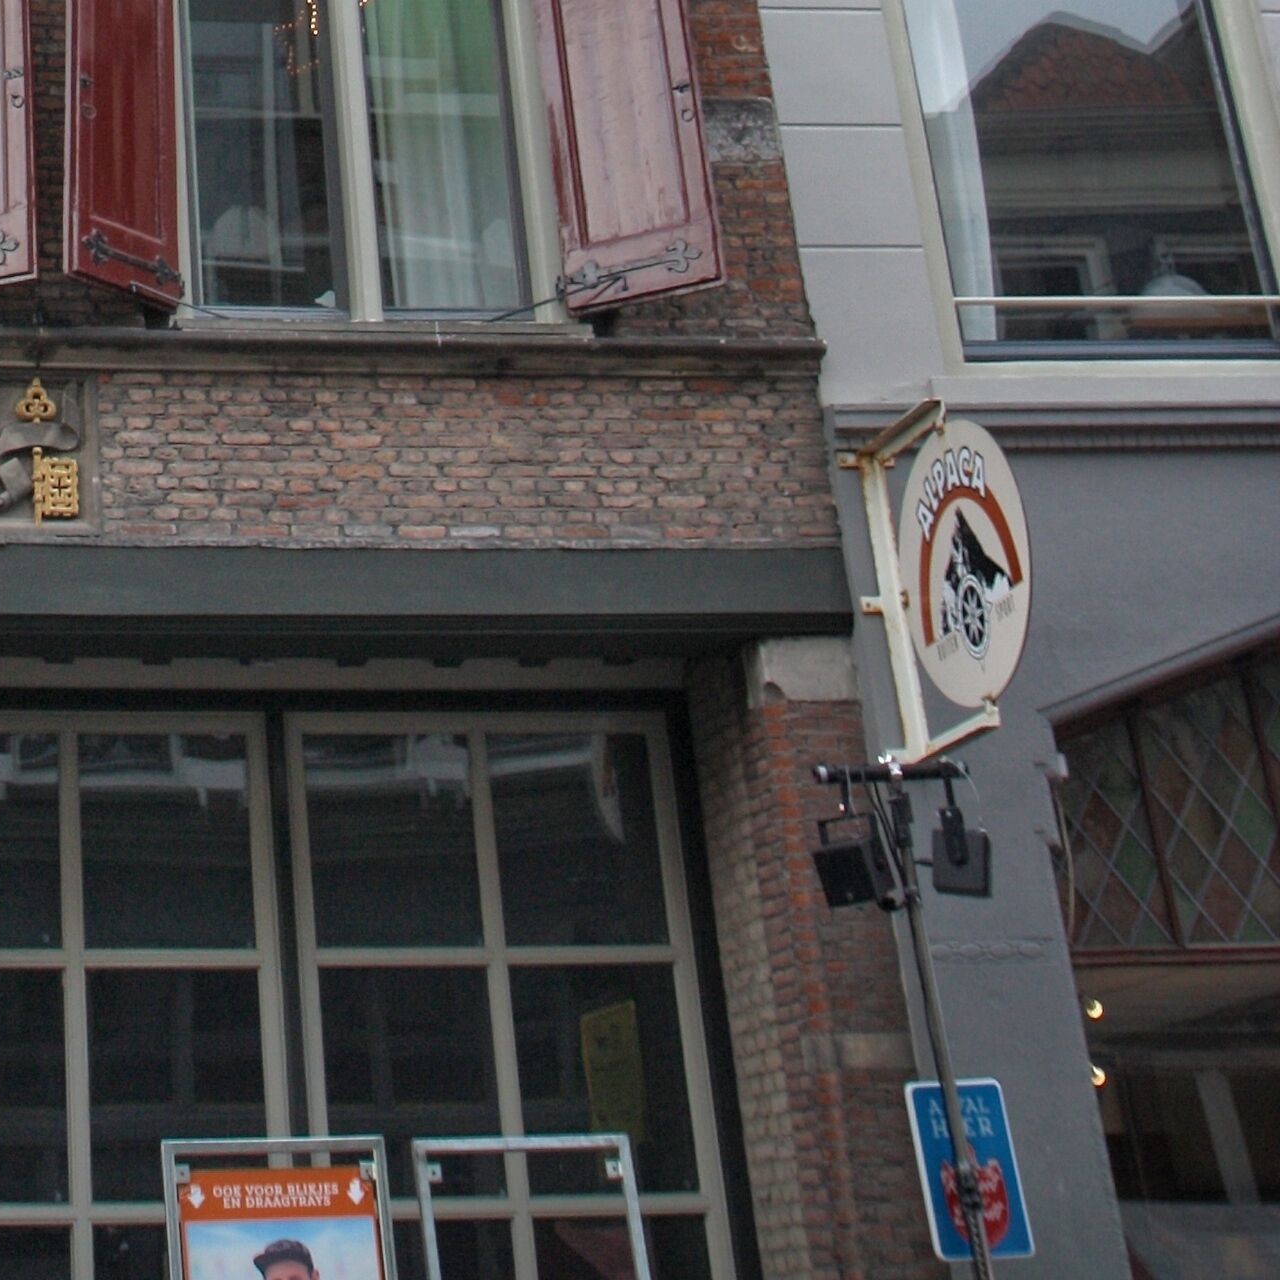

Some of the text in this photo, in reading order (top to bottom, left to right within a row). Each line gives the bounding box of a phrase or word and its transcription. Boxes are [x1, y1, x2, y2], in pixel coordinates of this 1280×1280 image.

[916, 446, 986, 541] ALPACA
[930, 1116, 994, 1139] HER
[212, 1182, 339, 1198] OOK VOOR BLIKJES
[223, 1195, 332, 1209] EN DRAAGTRAYS
